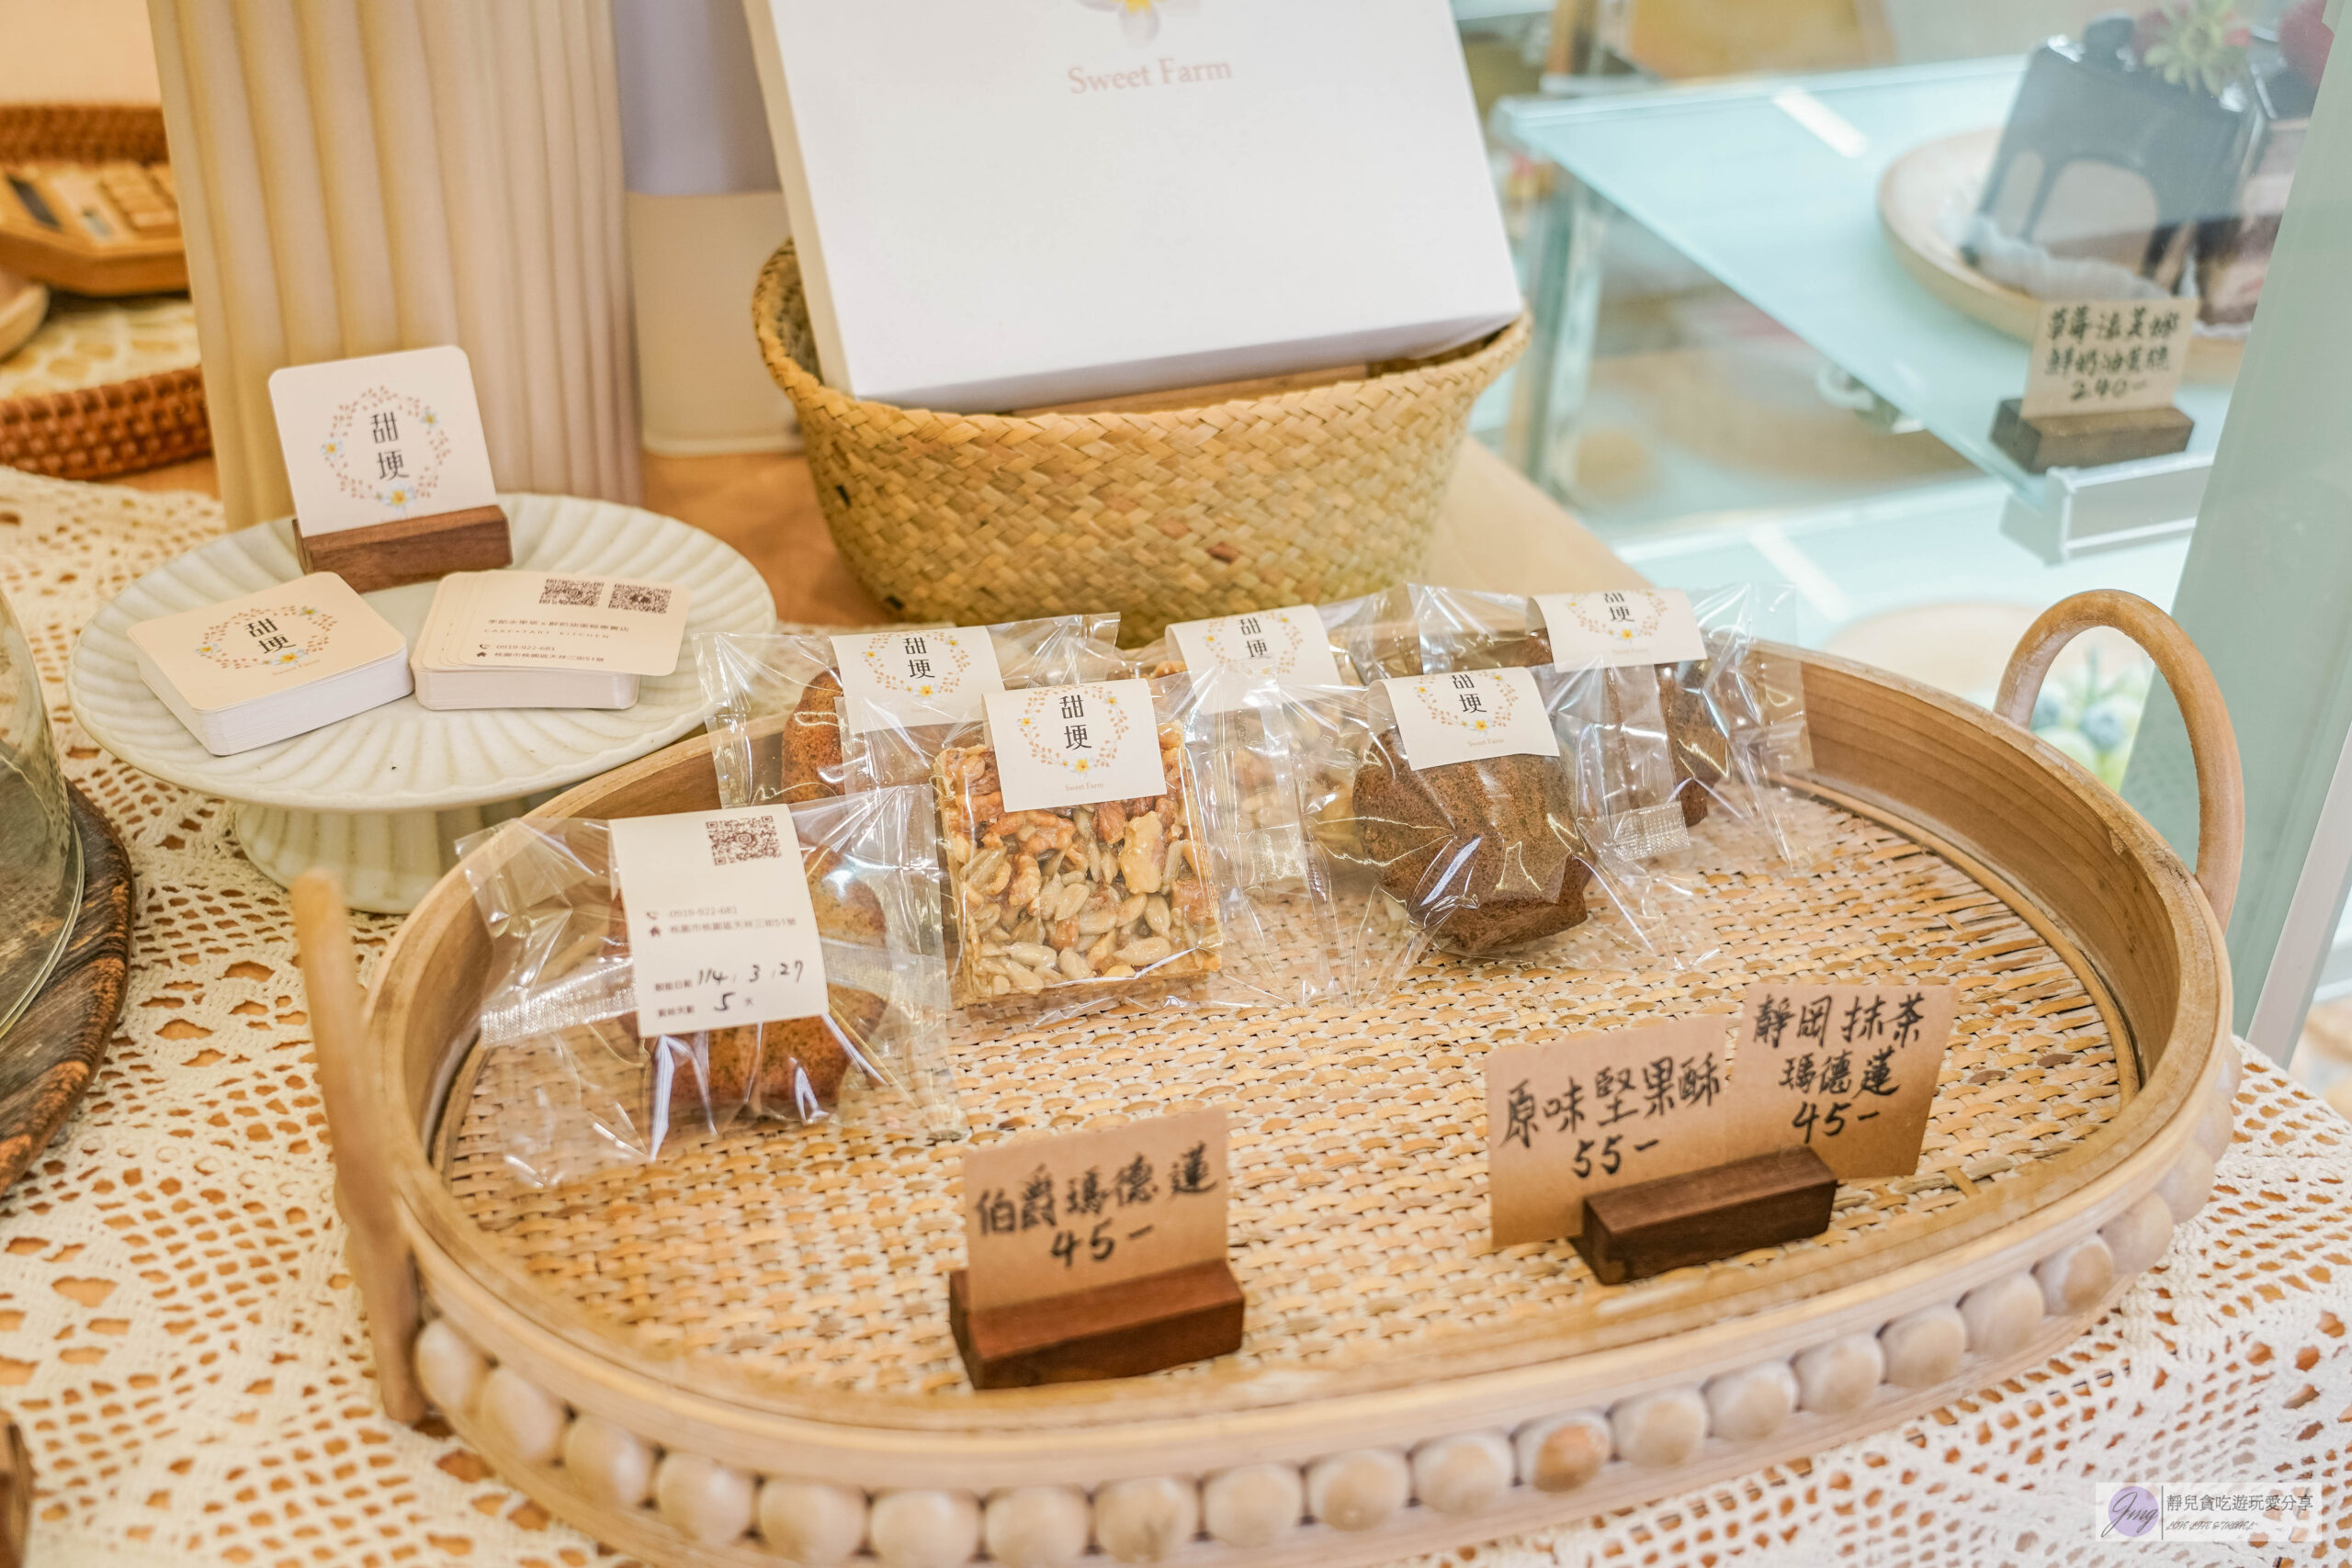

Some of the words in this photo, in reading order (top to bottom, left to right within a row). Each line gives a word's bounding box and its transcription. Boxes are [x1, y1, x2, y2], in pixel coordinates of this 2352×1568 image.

[1068, 65, 1151, 94] Sweet
[1158, 58, 1233, 84] Farm
[1499, 1051, 1720, 1148] 原味堅果酥
[1779, 1046, 1901, 1099] 瑪德蓮
[974, 1140, 1218, 1235] 伯爵瑪德蓮
